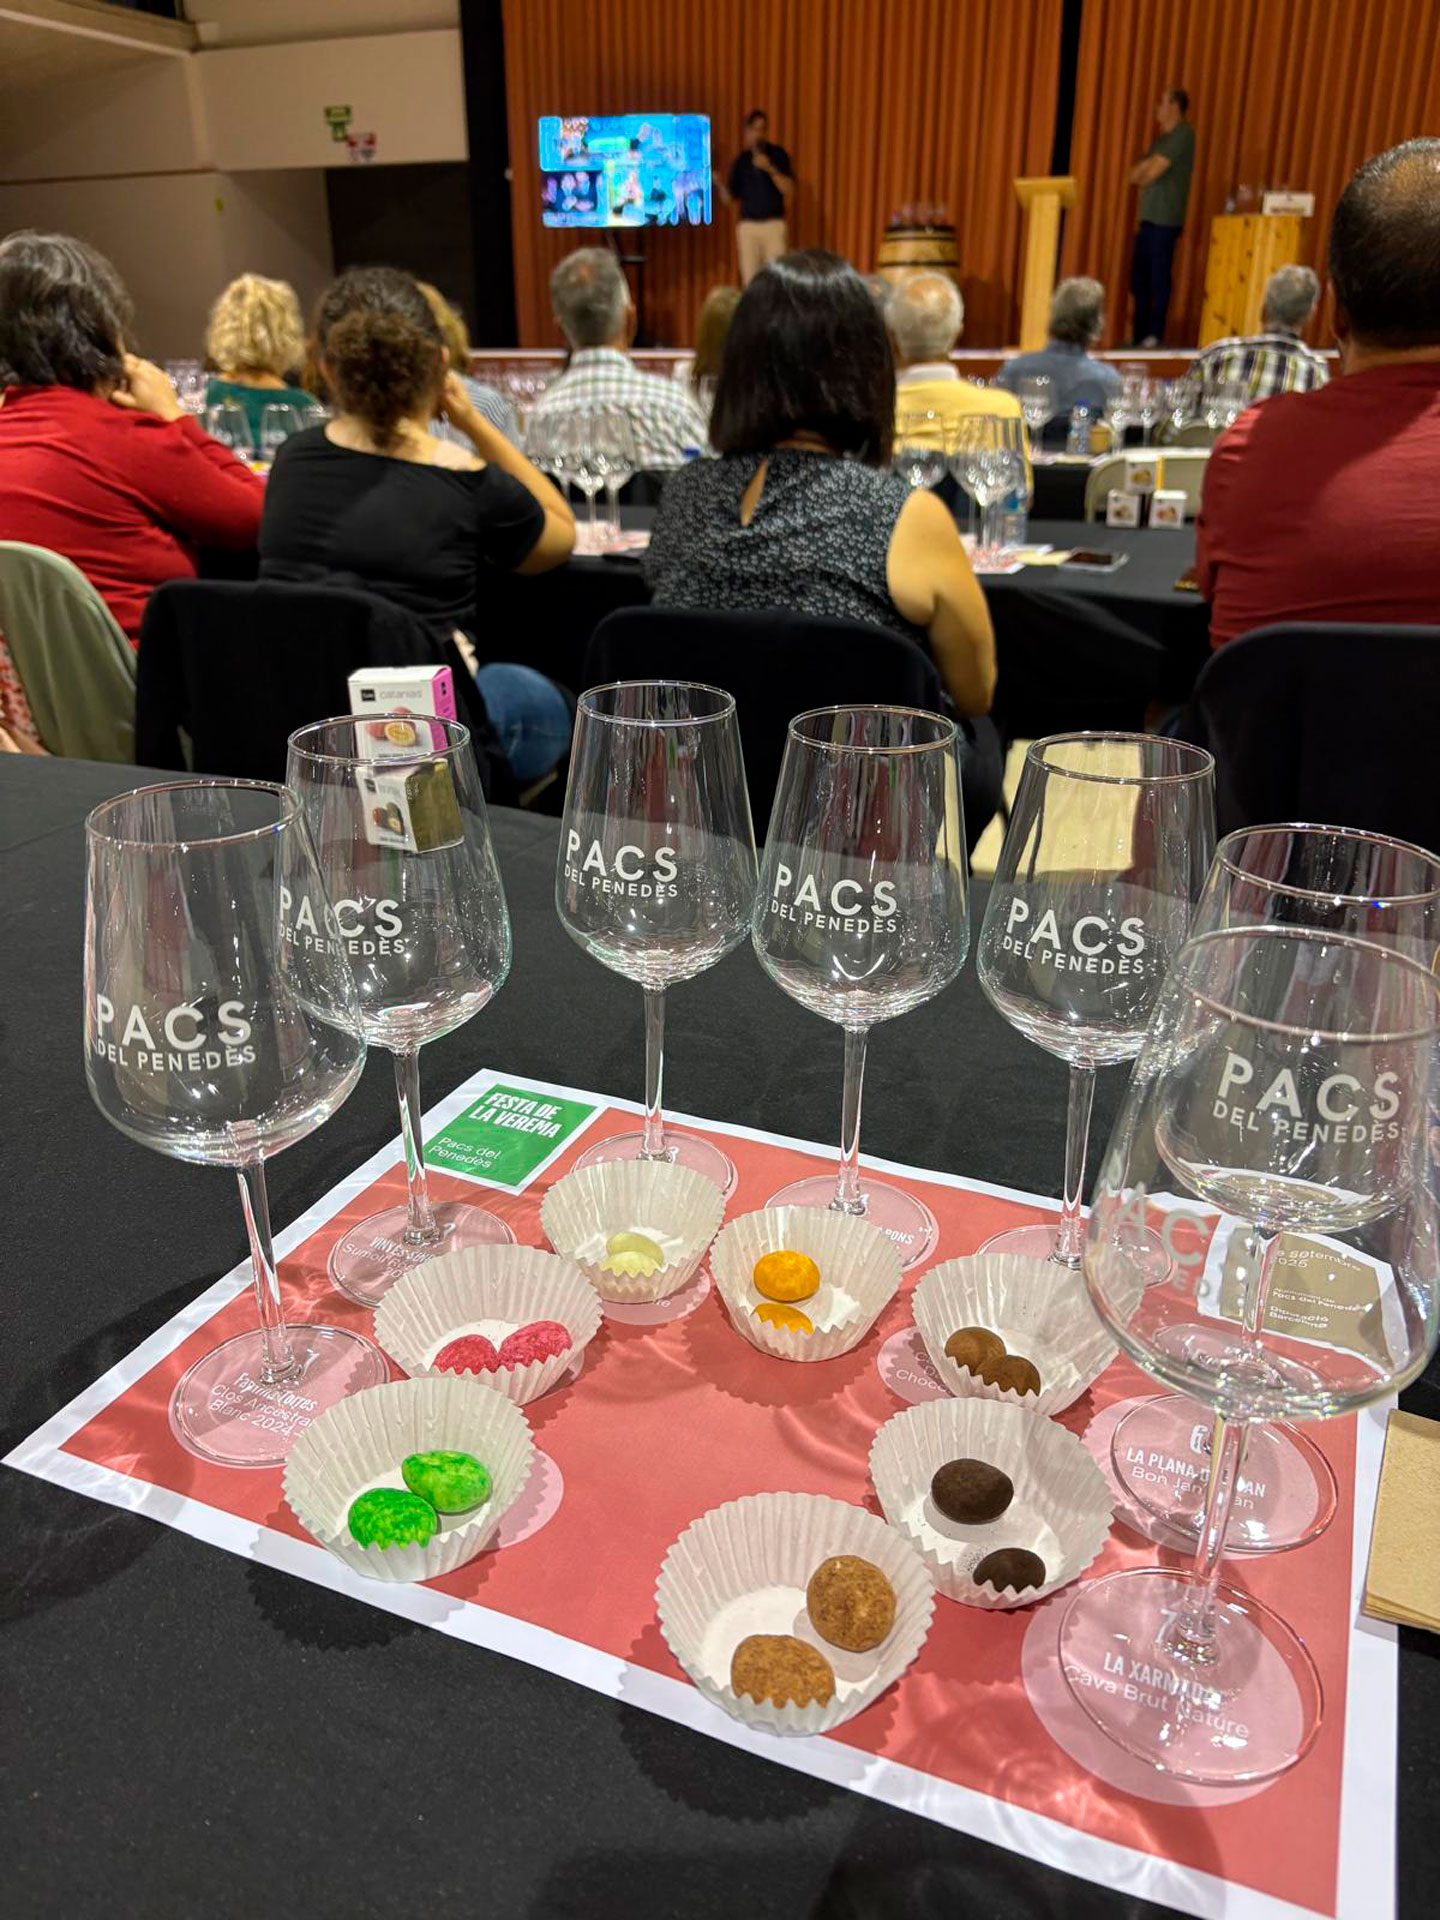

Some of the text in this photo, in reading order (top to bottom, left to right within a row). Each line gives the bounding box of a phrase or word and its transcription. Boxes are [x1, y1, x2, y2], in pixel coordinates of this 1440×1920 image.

[566, 828, 678, 882] PACS
[564, 863, 678, 897] DEL PENEDÈS
[773, 862, 897, 917] PACS
[279, 885, 403, 938] PACS
[771, 900, 897, 933] DEL PENEDÈS
[1006, 897, 1146, 957] PACS
[279, 923, 299, 946] DEL
[1003, 935, 1144, 975] DEL PENEDÈS
[97, 993, 252, 1050] PACS
[97, 1039, 256, 1072] DEL PENEDÈS
[1217, 1051, 1400, 1121] PACS
[468, 1105, 563, 1138] LA VEREMA
[484, 1092, 563, 1120] FESTA DE
[1212, 1099, 1400, 1144] DEL PENEDÈS
[428, 1145, 493, 1168] Penedès
[438, 1136, 502, 1160] Pacs del
[1276, 1258, 1308, 1268] 025
[208, 1399, 295, 1436] Blanc 2024
[212, 1384, 316, 1428] Clos Ancestral
[1126, 1448, 1144, 1465] LA
[1148, 1453, 1197, 1478] PLANA
[1132, 1466, 1168, 1485] Bon
[1104, 1652, 1124, 1676] LA
[1064, 1665, 1249, 1738] Cava Brut Nature
